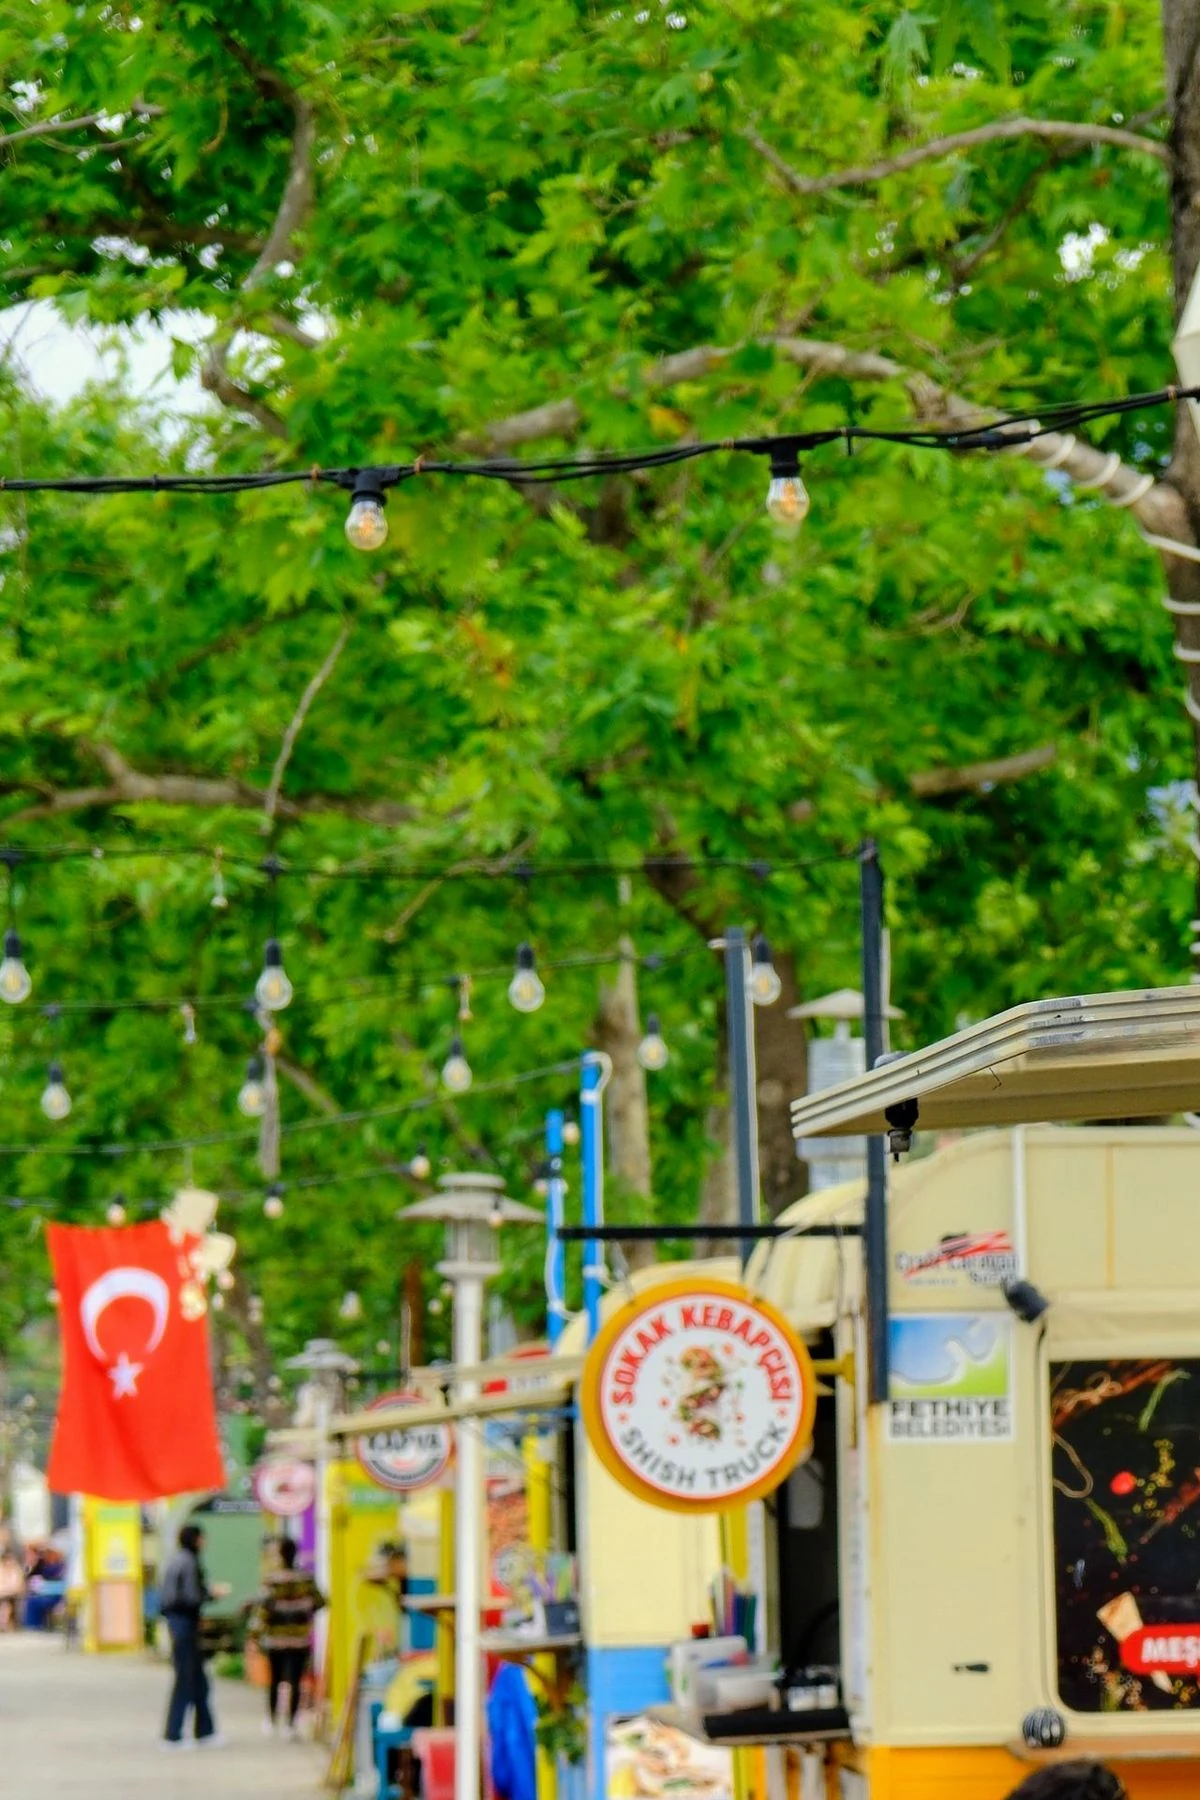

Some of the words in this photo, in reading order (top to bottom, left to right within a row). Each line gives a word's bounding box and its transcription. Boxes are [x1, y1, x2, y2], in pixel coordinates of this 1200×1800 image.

[612, 1315, 673, 1404] SOKAK
[681, 1306, 792, 1400] KEBAPÇISI
[620, 1426, 697, 1488] SHISH
[704, 1422, 788, 1488] TRUCK
